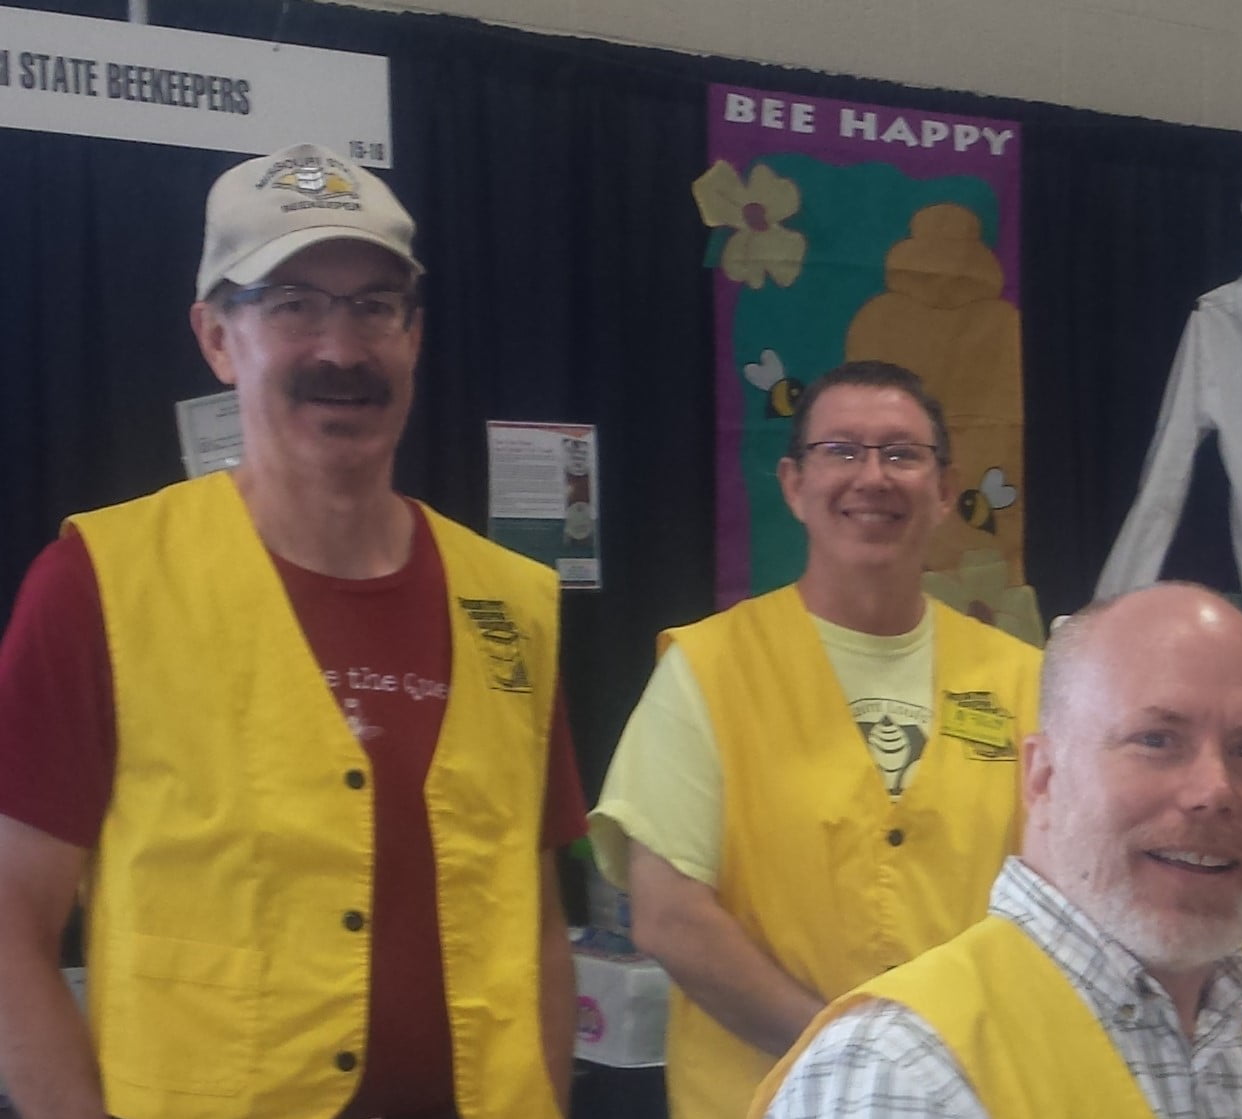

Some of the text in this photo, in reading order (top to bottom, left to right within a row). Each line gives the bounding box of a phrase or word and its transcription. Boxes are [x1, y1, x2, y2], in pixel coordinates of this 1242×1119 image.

[20, 52, 97, 96] STATE
[106, 62, 251, 114] BEEKEEPERS
[724, 93, 1015, 156] BEE HAPPY
[347, 666, 398, 692] the
